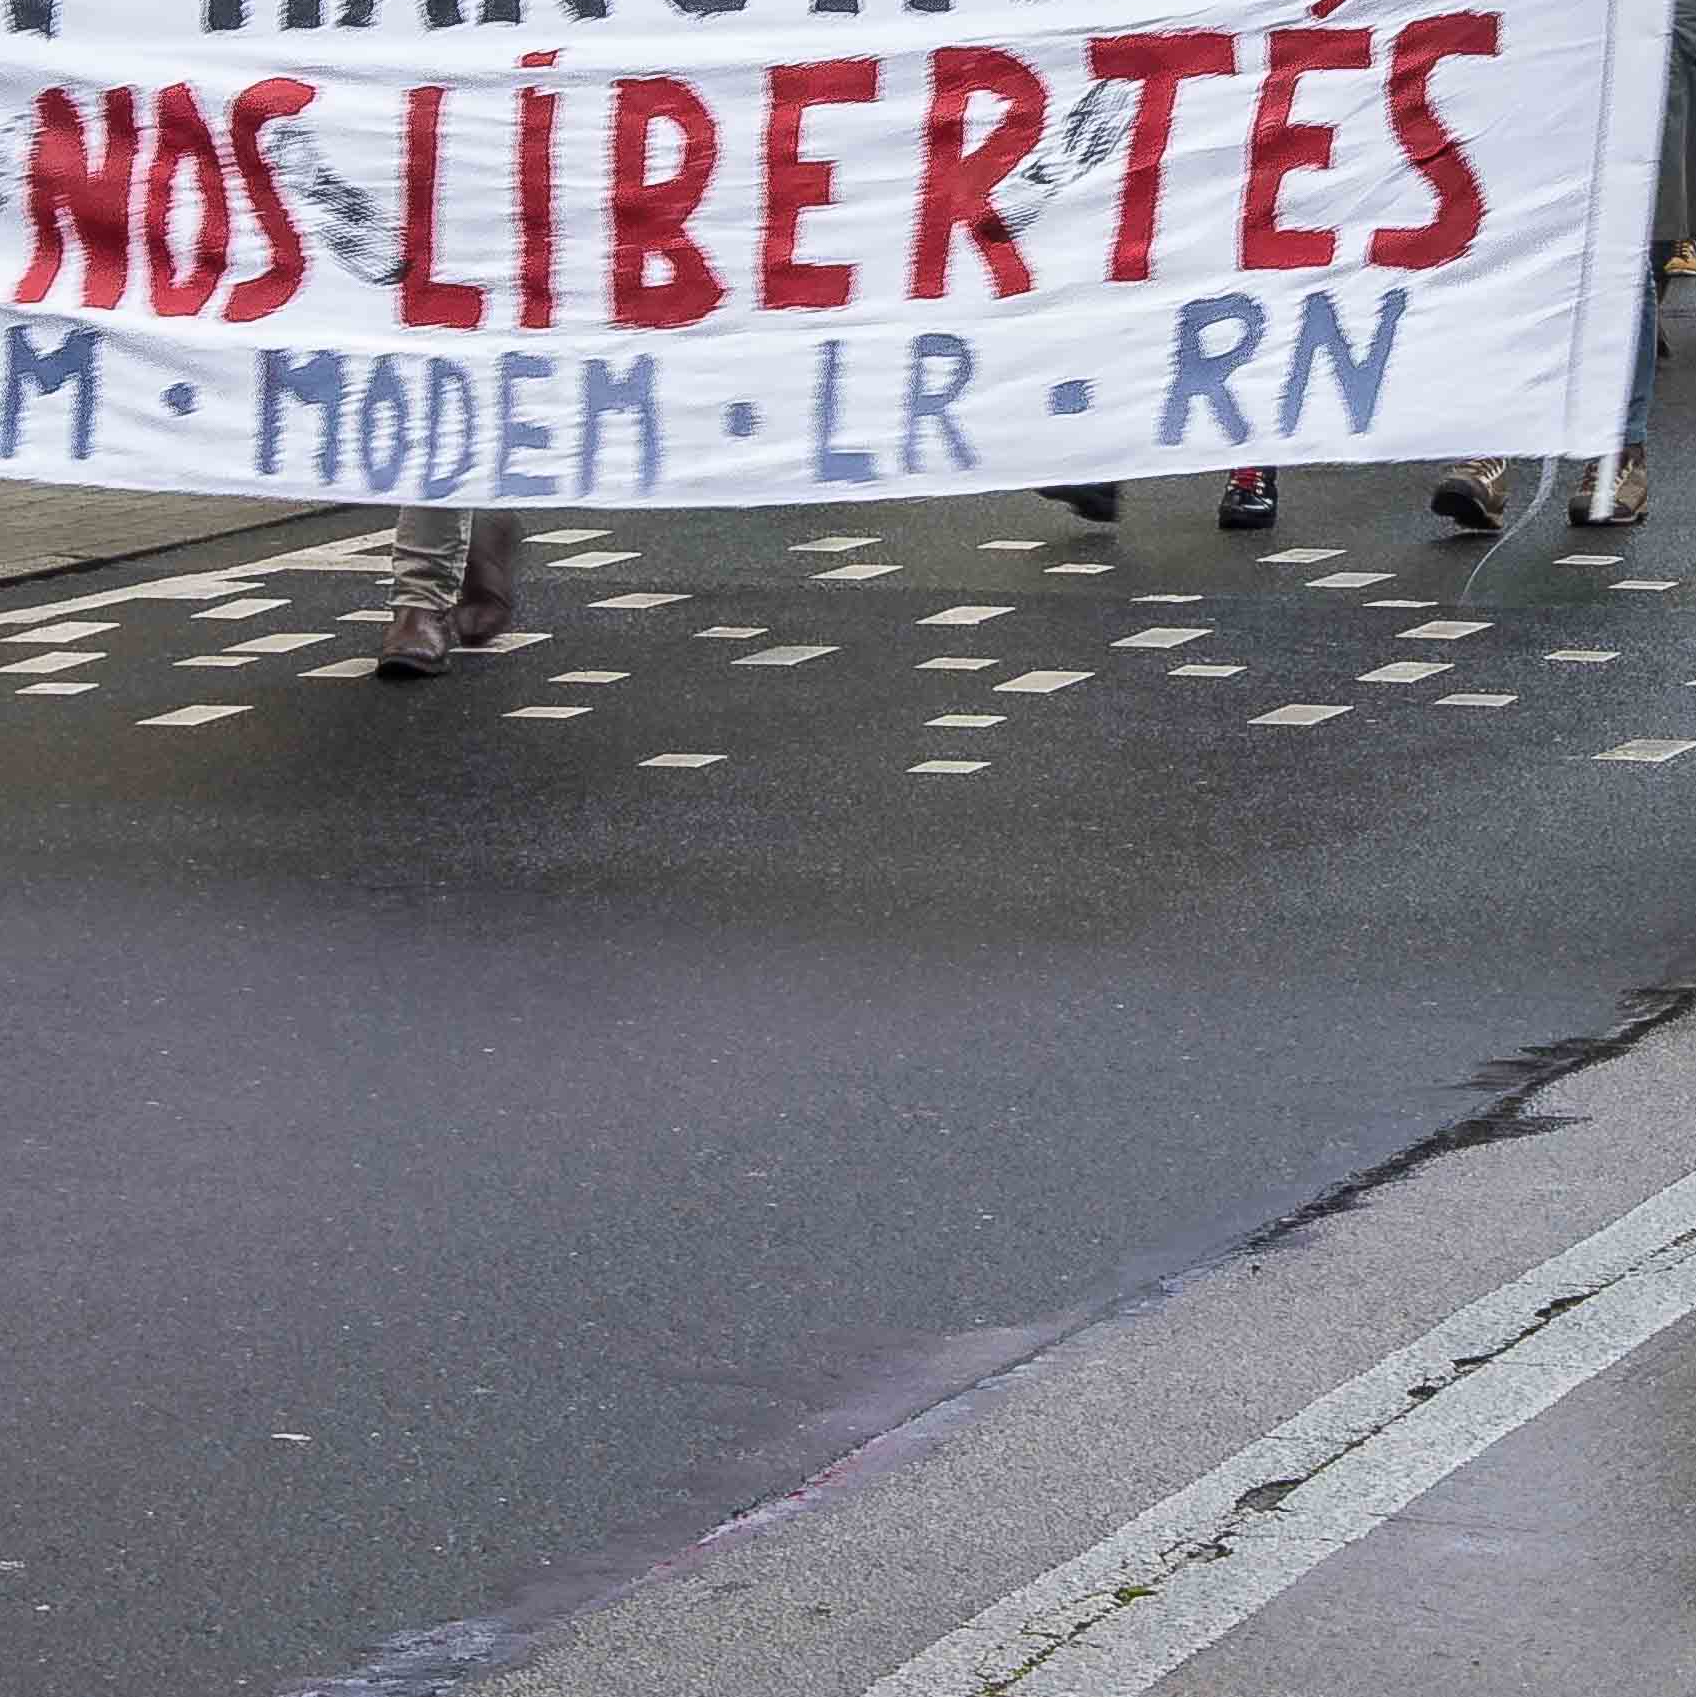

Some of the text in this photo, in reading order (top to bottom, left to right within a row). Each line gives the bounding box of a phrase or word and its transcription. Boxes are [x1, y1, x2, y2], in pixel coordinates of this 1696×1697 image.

[14, 76, 317, 325] NOS
[253, 344, 661, 502] MODEM
[813, 330, 979, 486] LR
[1154, 287, 1408, 448] RN
